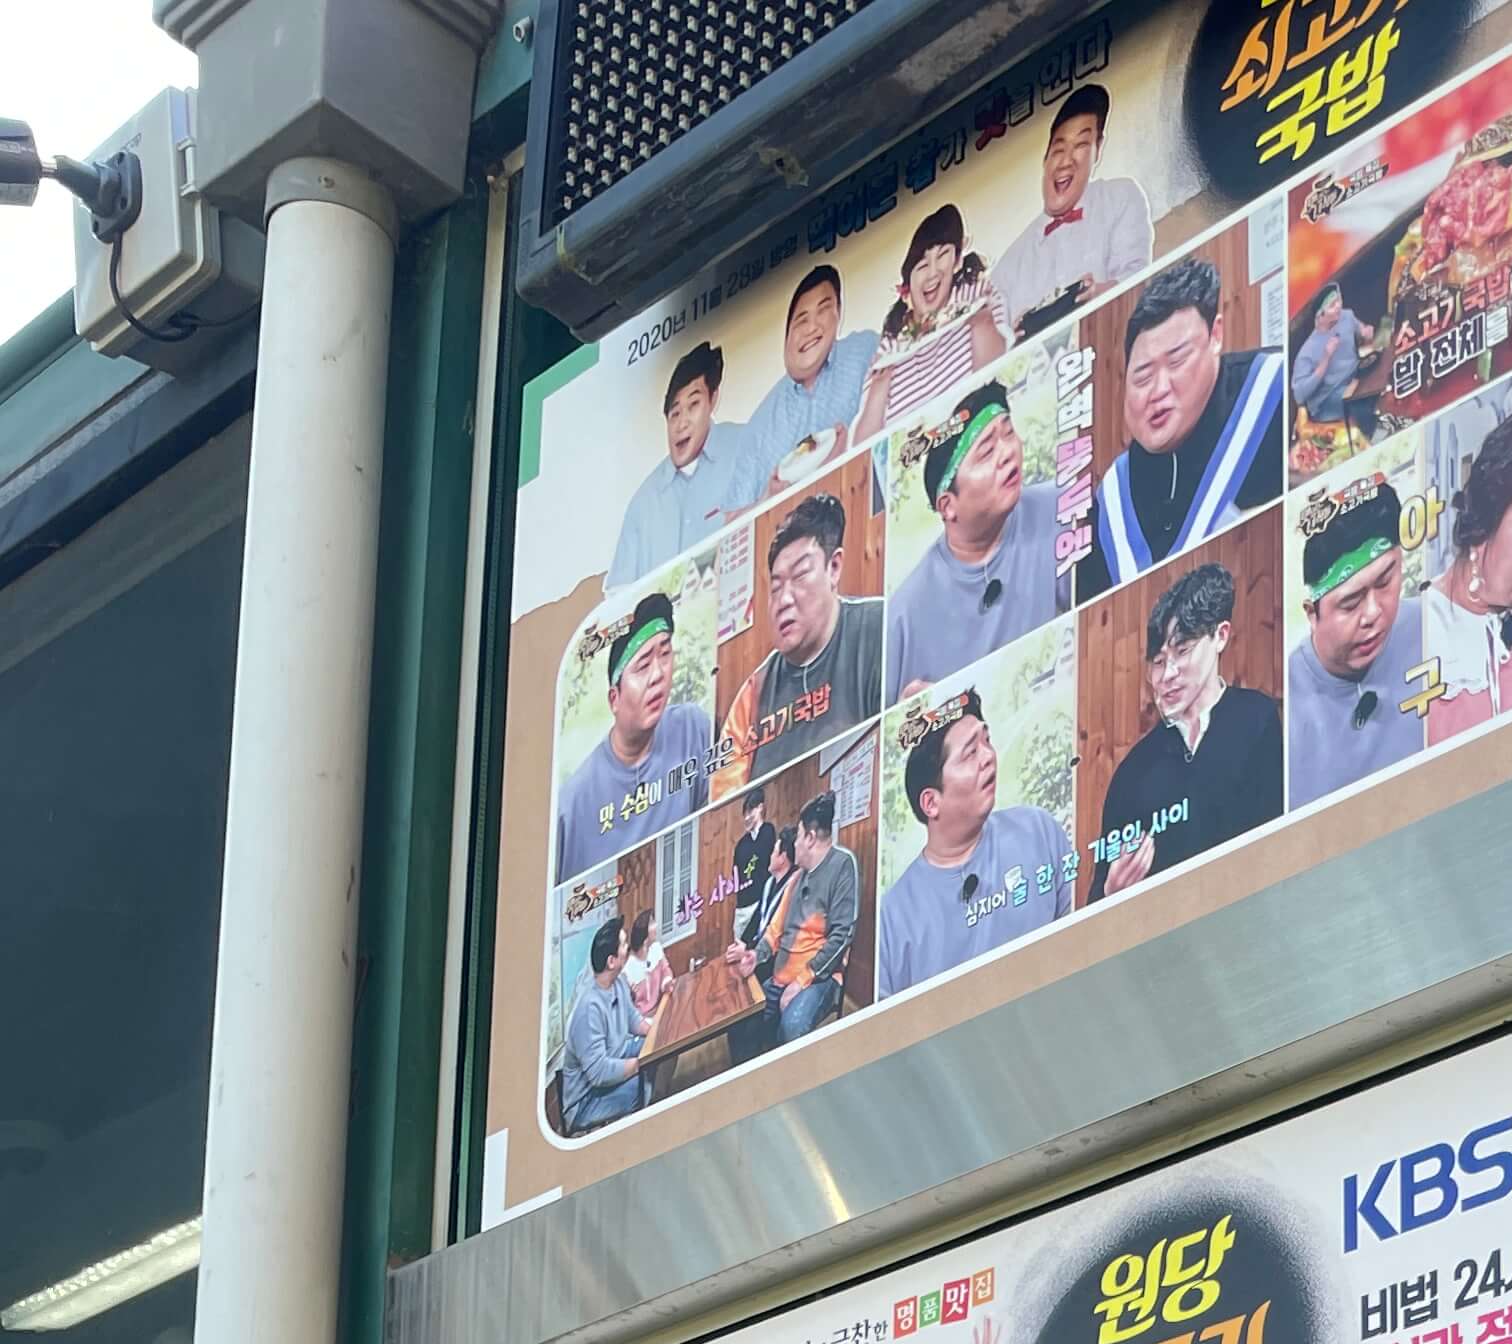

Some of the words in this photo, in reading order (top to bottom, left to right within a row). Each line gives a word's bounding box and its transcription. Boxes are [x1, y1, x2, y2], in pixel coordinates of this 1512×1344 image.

[1220, 0, 1408, 112] 쇠고
[1256, 17, 1400, 164] 국밥
[626, 307, 688, 367] 2020년
[1039, 17, 1113, 106] 안다
[1429, 305, 1510, 379] 전체를
[599, 802, 615, 833] 맛
[618, 780, 663, 821] 수심이
[667, 757, 700, 796] 매우
[702, 735, 737, 775] 깊은
[739, 684, 834, 758] 소고기국밥
[964, 889, 1007, 927] 심지어
[1034, 861, 1056, 898] 한
[1061, 849, 1082, 884] 잔
[1086, 819, 1144, 870] 기울인
[1147, 796, 1191, 839] 사이
[893, 1268, 995, 1338] 명품맛집
[1359, 1269, 1440, 1340] 비법
